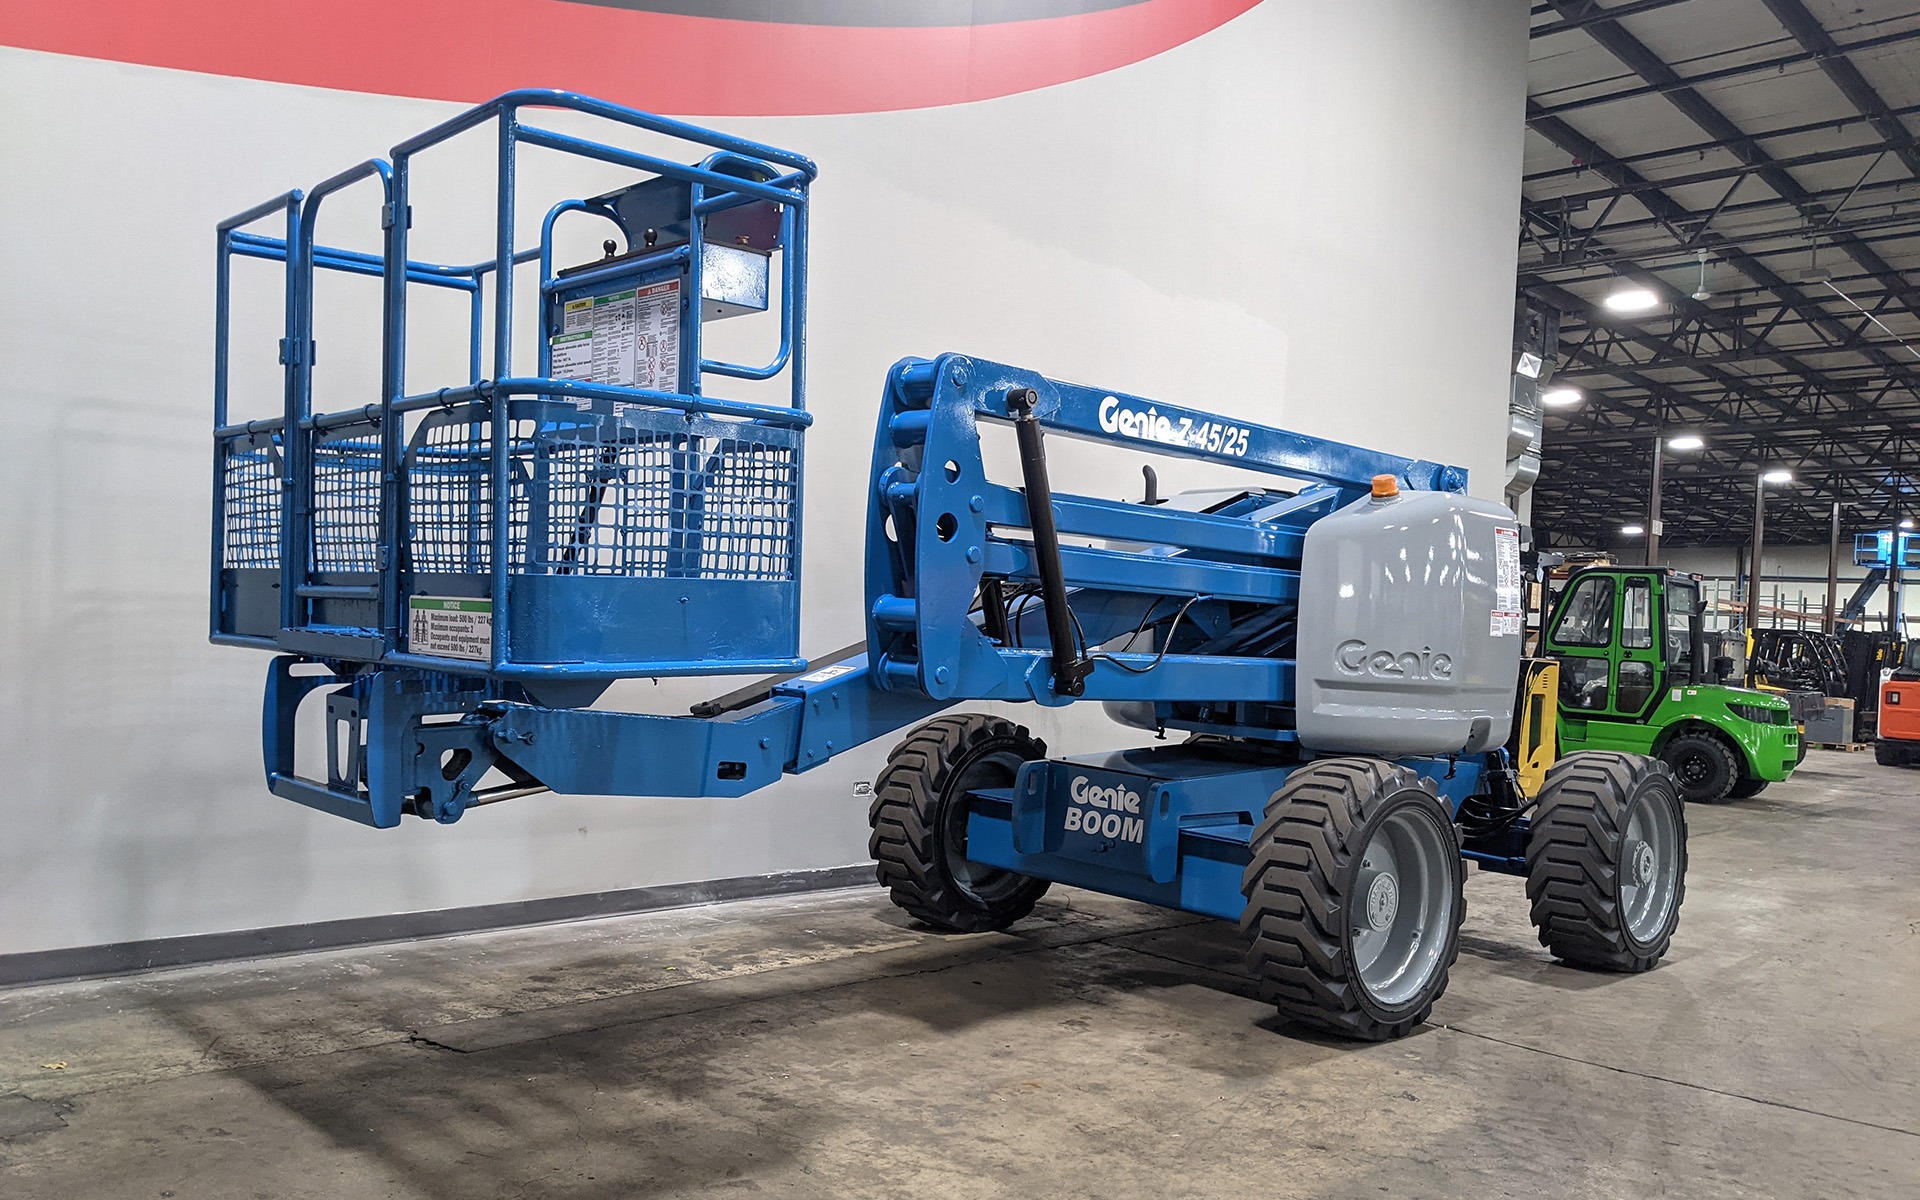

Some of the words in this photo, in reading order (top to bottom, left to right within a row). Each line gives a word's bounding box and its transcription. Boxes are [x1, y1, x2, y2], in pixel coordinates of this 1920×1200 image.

[652, 284, 670, 293] DANGER
[560, 333, 586, 342] INSTRUCTIONS
[1098, 395, 1172, 441] Genie
[1176, 416, 1251, 458] Z-45/25
[443, 601, 461, 610] NOTICE
[430, 613, 448, 622] Maximum
[459, 614, 468, 623] 500
[477, 615, 486, 625] 227
[430, 622, 448, 631] Maximum
[470, 625, 474, 633] 2
[430, 632, 450, 642] Occupants
[450, 634, 458, 642] and
[458, 635, 480, 644] equipment
[480, 636, 490, 645] must
[437, 643, 450, 651] exceed
[450, 643, 458, 652] 500
[1335, 639, 1452, 681] Genie
[1070, 775, 1141, 814] Genie
[1064, 806, 1145, 844] BOOM
